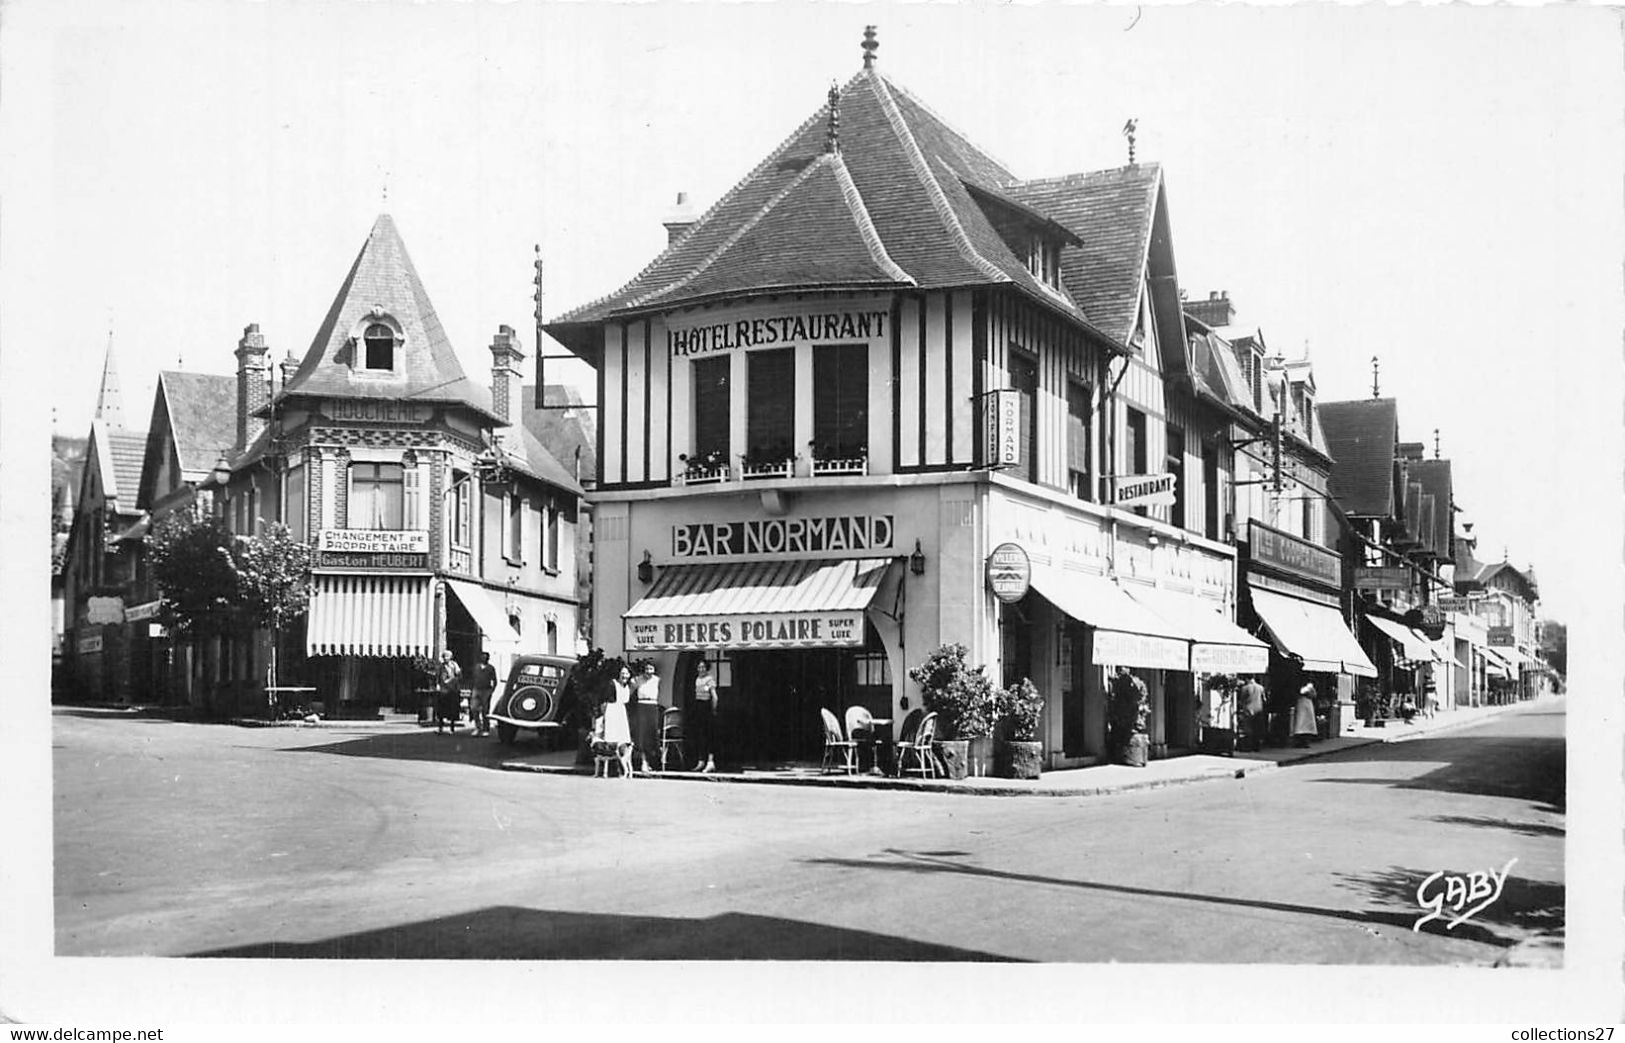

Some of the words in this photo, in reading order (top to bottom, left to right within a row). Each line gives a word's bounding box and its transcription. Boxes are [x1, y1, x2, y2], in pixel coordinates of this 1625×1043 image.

[735, 311, 888, 348] RESTAURANT
[1004, 400, 1014, 461] NORMAND
[1118, 477, 1171, 502] RESTAURANT
[325, 531, 404, 542] CHANGEMENT
[674, 522, 733, 556] BAR
[743, 515, 893, 553] NORMAND
[326, 541, 417, 551] PROPRIETAIRE
[322, 554, 367, 566] Gaston
[634, 625, 658, 633] SUPER
[828, 619, 855, 628] SUPER
[664, 621, 732, 643] BIERES
[741, 618, 823, 641] POLAIRE
[831, 630, 852, 639] LUXE
[637, 636, 655, 644] LUXE
